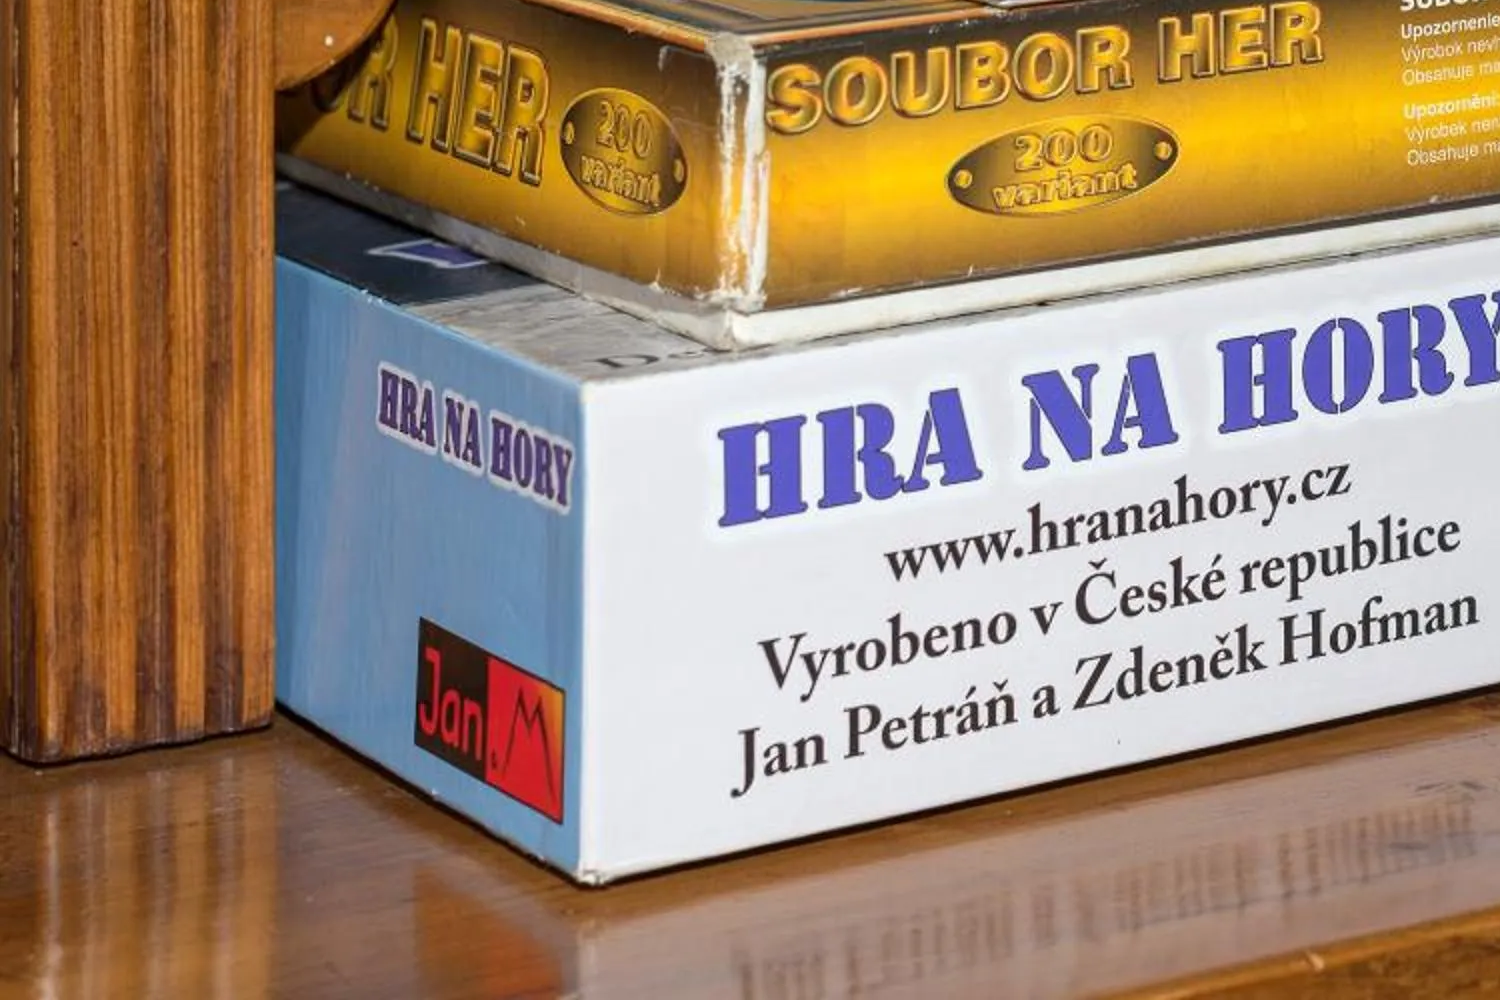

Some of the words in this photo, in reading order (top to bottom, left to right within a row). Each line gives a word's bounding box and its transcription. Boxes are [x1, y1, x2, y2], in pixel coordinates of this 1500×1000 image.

[764, 25, 1132, 136] SOUBOR
[1157, 1, 1325, 83] HER
[1401, 42, 1463, 64] Výrobok
[1402, 64, 1474, 87] Obsahuje
[406, 17, 550, 186] HER
[597, 100, 653, 159] 200
[1405, 118, 1468, 144] Výrobek
[1013, 123, 1114, 172] 200
[1407, 144, 1479, 168] Obsahuje
[581, 154, 661, 207] variant
[993, 160, 1139, 211] variant
[378, 367, 436, 448] HRA
[444, 396, 483, 469] NA
[491, 415, 573, 507] HORY
[716, 387, 983, 528] HRA
[1020, 351, 1179, 472] NA
[884, 462, 1354, 583] www.hranahory.cz
[758, 608, 1018, 703] Vyrobeno
[1030, 600, 1063, 638] v
[1074, 555, 1225, 627] České
[1238, 511, 1463, 602] republice
[730, 725, 828, 798] Jan
[842, 680, 1019, 761] Petráň
[1030, 685, 1060, 719] a
[1072, 624, 1267, 712] Zdeněk
[1277, 594, 1480, 668] Hofman
